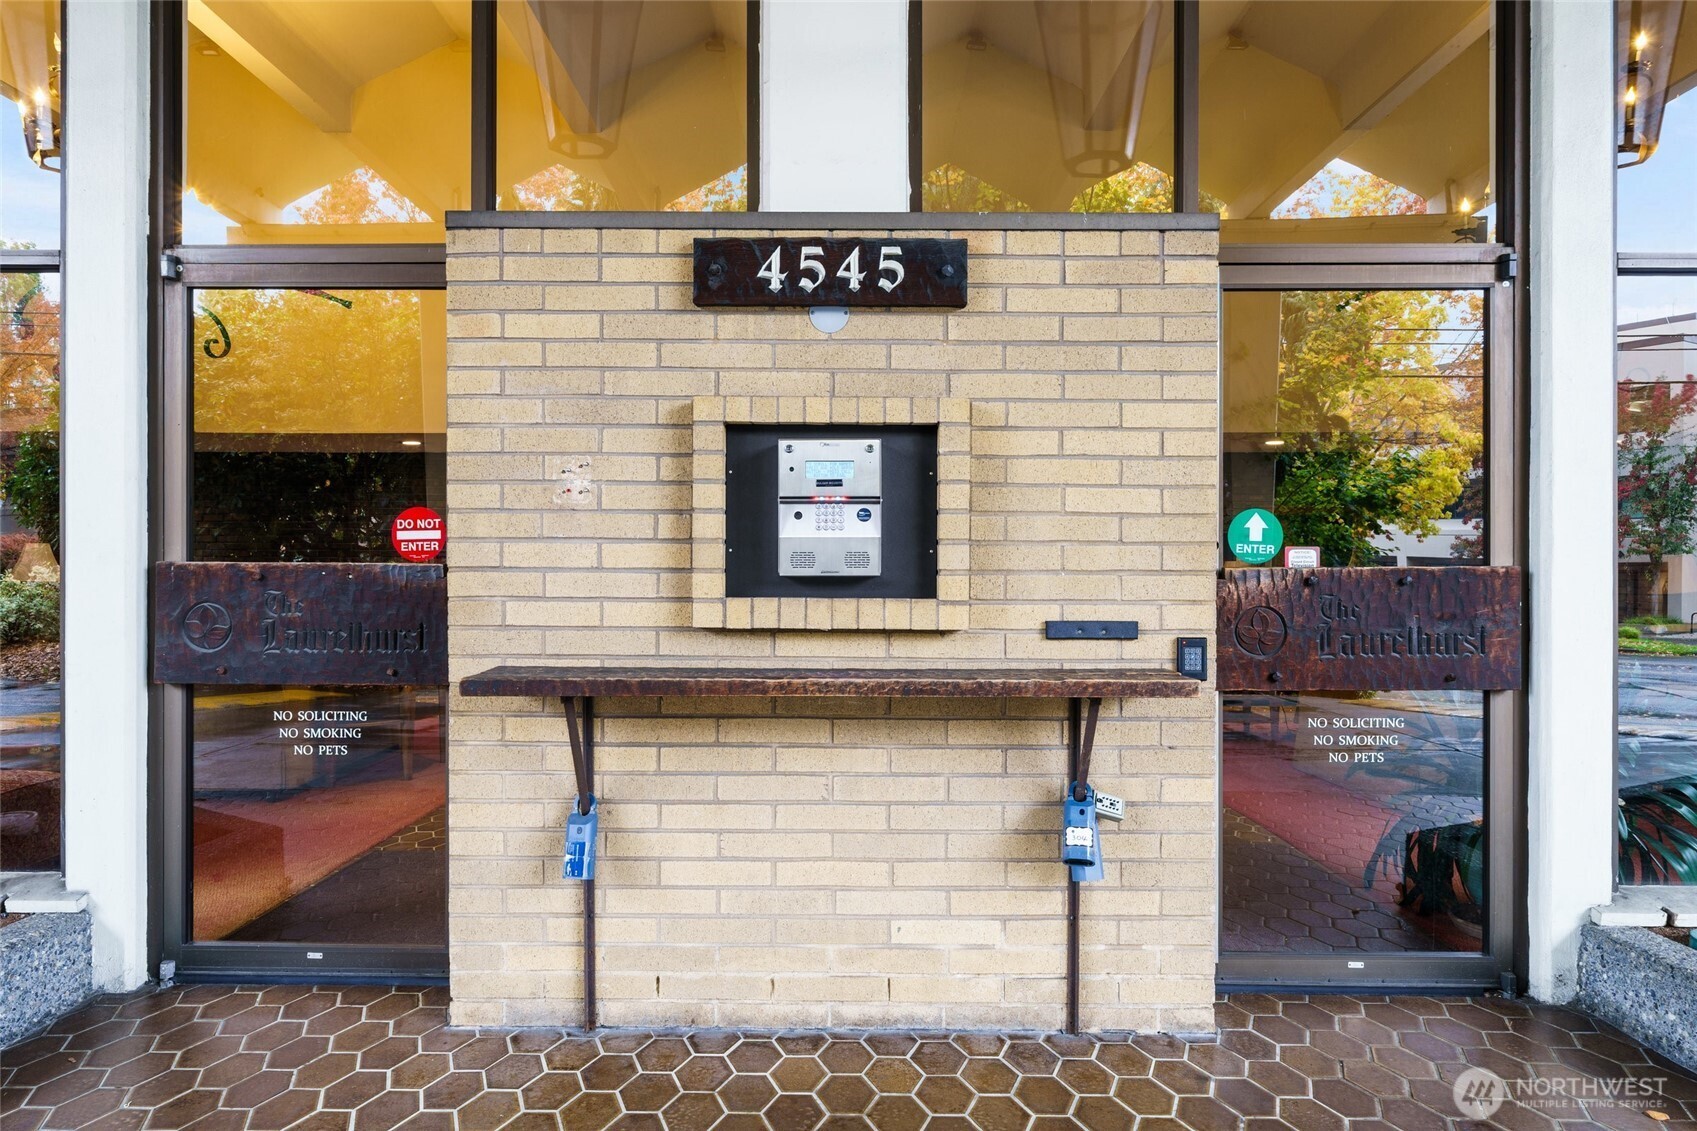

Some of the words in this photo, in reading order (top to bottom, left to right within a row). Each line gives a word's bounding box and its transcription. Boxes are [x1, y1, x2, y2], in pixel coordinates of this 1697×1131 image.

[757, 245, 905, 293] 4545
[396, 519, 414, 529] DO
[416, 518, 441, 529] NOT
[400, 541, 439, 552] ENTER
[1235, 543, 1275, 555] ENTER
[264, 590, 304, 618] The
[1319, 594, 1361, 624] The
[262, 619, 428, 657] Laurelhurst
[1316, 619, 1487, 661] Laurelhurst
[273, 710, 293, 721] NO
[297, 710, 368, 722] SOLICITING
[1307, 717, 1328, 729] NO
[1332, 717, 1405, 729] SOLICITING
[279, 727, 299, 739] NO
[303, 727, 362, 739] SMOKING
[1313, 734, 1334, 746] NO
[1338, 734, 1399, 746] SMOKING
[293, 744, 314, 756] NO
[318, 745, 348, 756] PETS
[1328, 752, 1349, 763] NO
[1353, 751, 1385, 763] PETS
